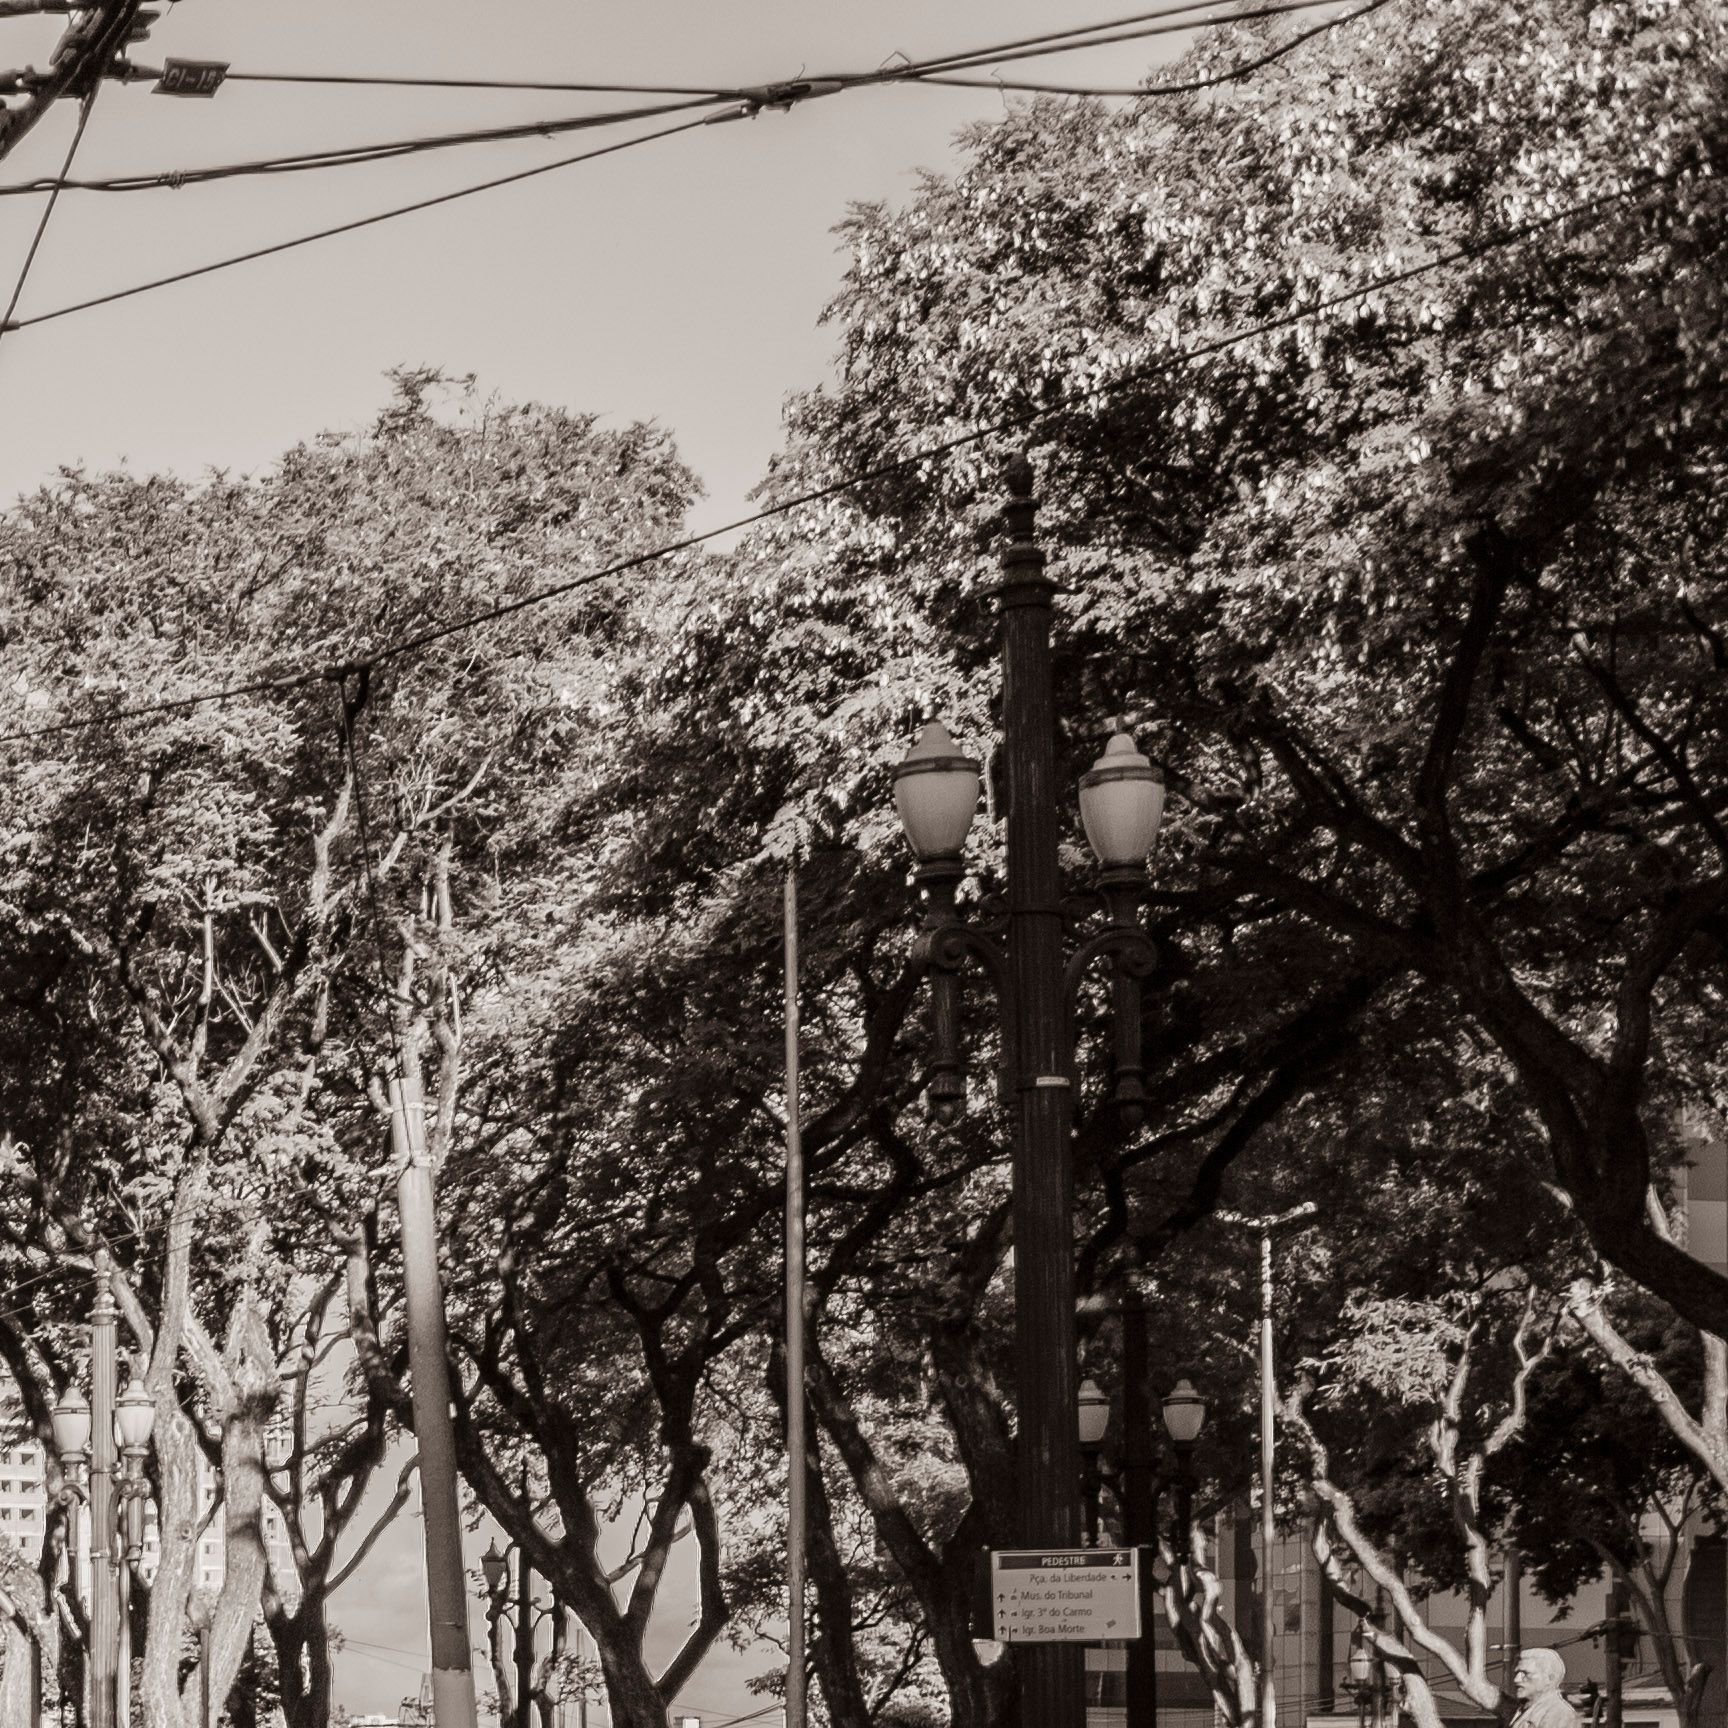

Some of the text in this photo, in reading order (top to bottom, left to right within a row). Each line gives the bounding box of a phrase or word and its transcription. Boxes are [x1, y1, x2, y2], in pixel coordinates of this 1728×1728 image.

[1041, 1556, 1087, 1566] PEDESTRE
[1050, 1573, 1061, 1582] da
[1064, 1572, 1107, 1582] Liberdade
[1020, 1589, 1094, 1600] Mus. do Tribunal
[1048, 1607, 1061, 1617] do
[1063, 1607, 1093, 1617] Carmo
[1038, 1625, 1055, 1634] Boa
[1057, 1624, 1085, 1634] Morte
